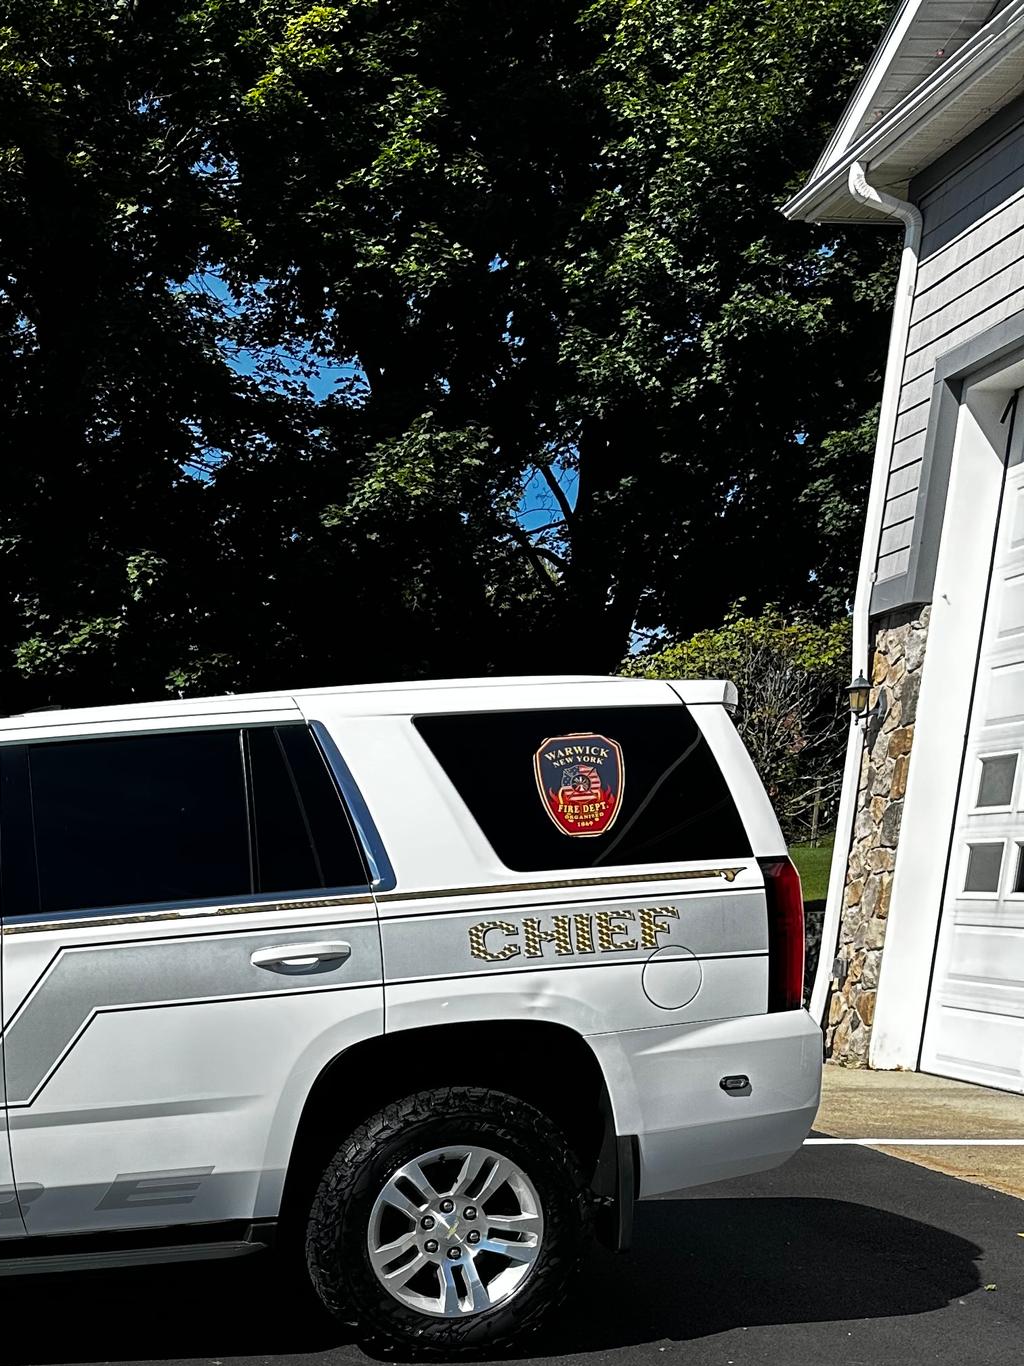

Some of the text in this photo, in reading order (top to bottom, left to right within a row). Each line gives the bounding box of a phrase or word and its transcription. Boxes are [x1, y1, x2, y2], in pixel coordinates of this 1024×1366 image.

[544, 746, 610, 761] WARWICK
[553, 755, 604, 768] NEW YORK
[558, 801, 610, 814] FIRE DEPT.
[468, 905, 680, 962] CHIEF
